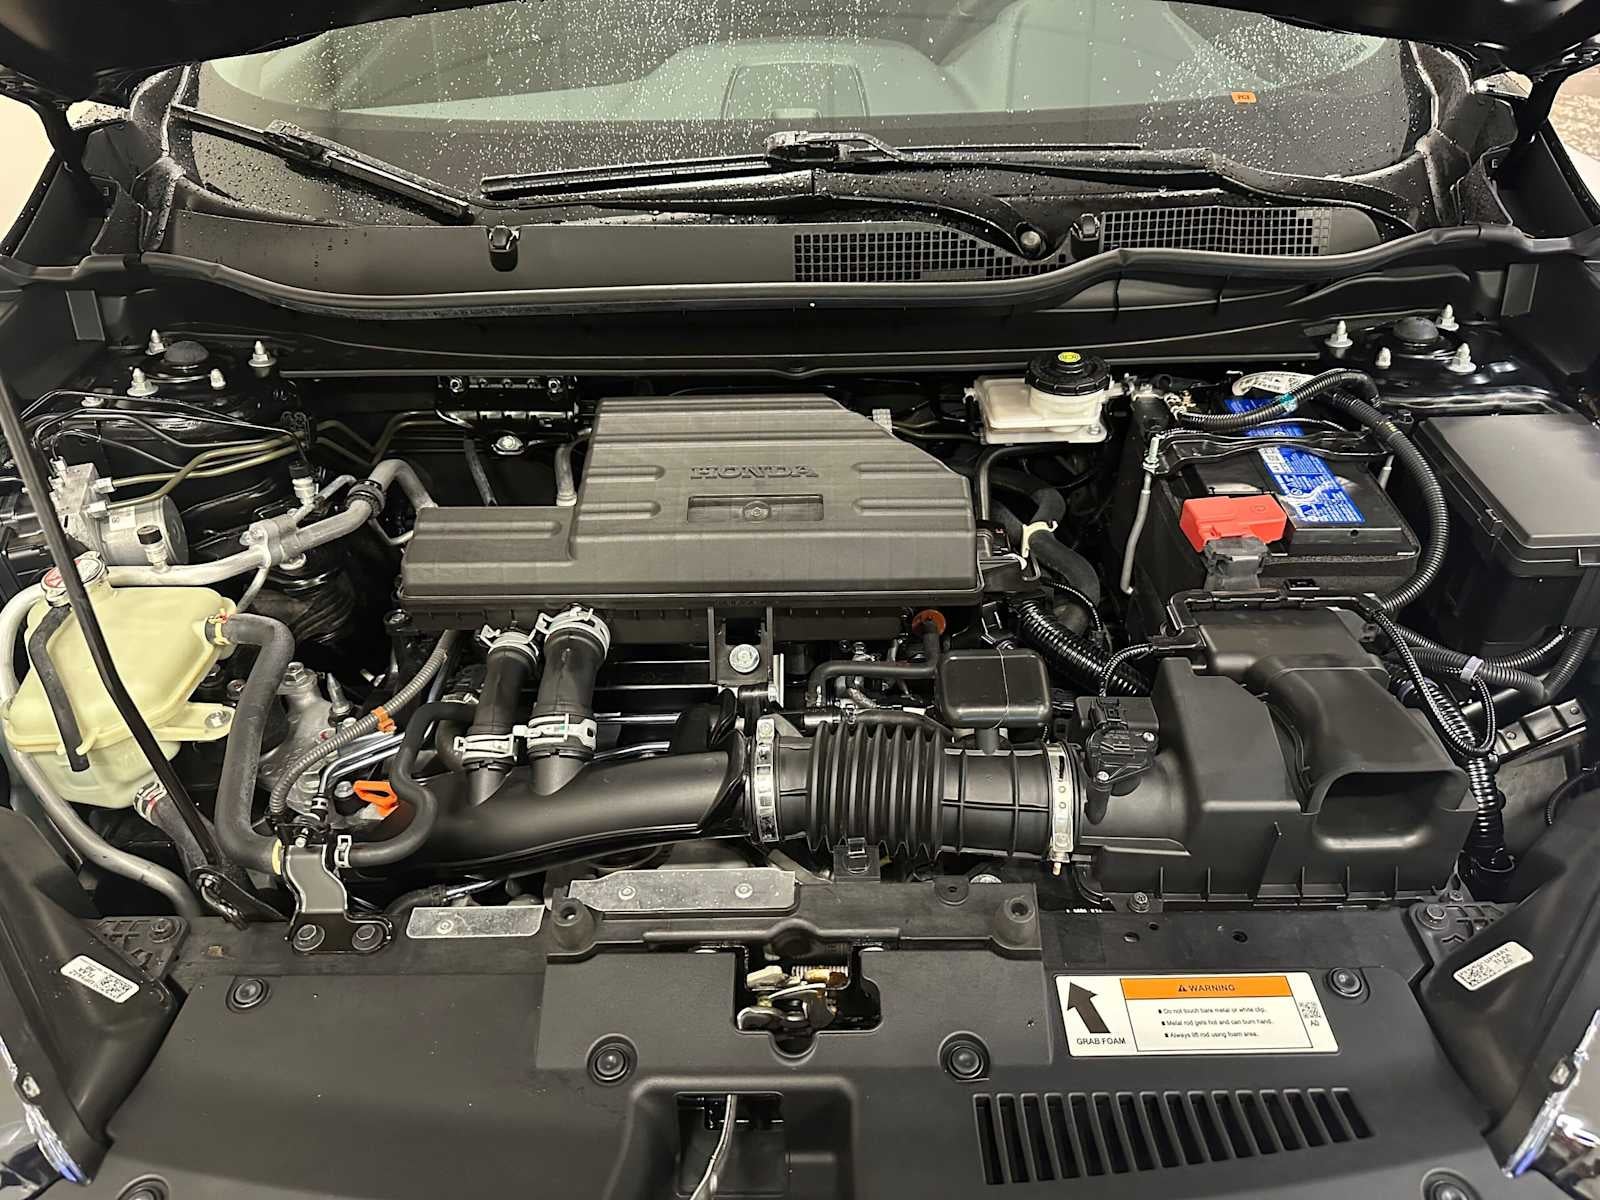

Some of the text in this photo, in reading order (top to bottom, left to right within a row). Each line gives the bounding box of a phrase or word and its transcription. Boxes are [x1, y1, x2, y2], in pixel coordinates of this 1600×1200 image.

[690, 464, 819, 480] HONDA
[1188, 984, 1236, 992] WARNING
[1076, 1037, 1126, 1045] GRAB FOAM
